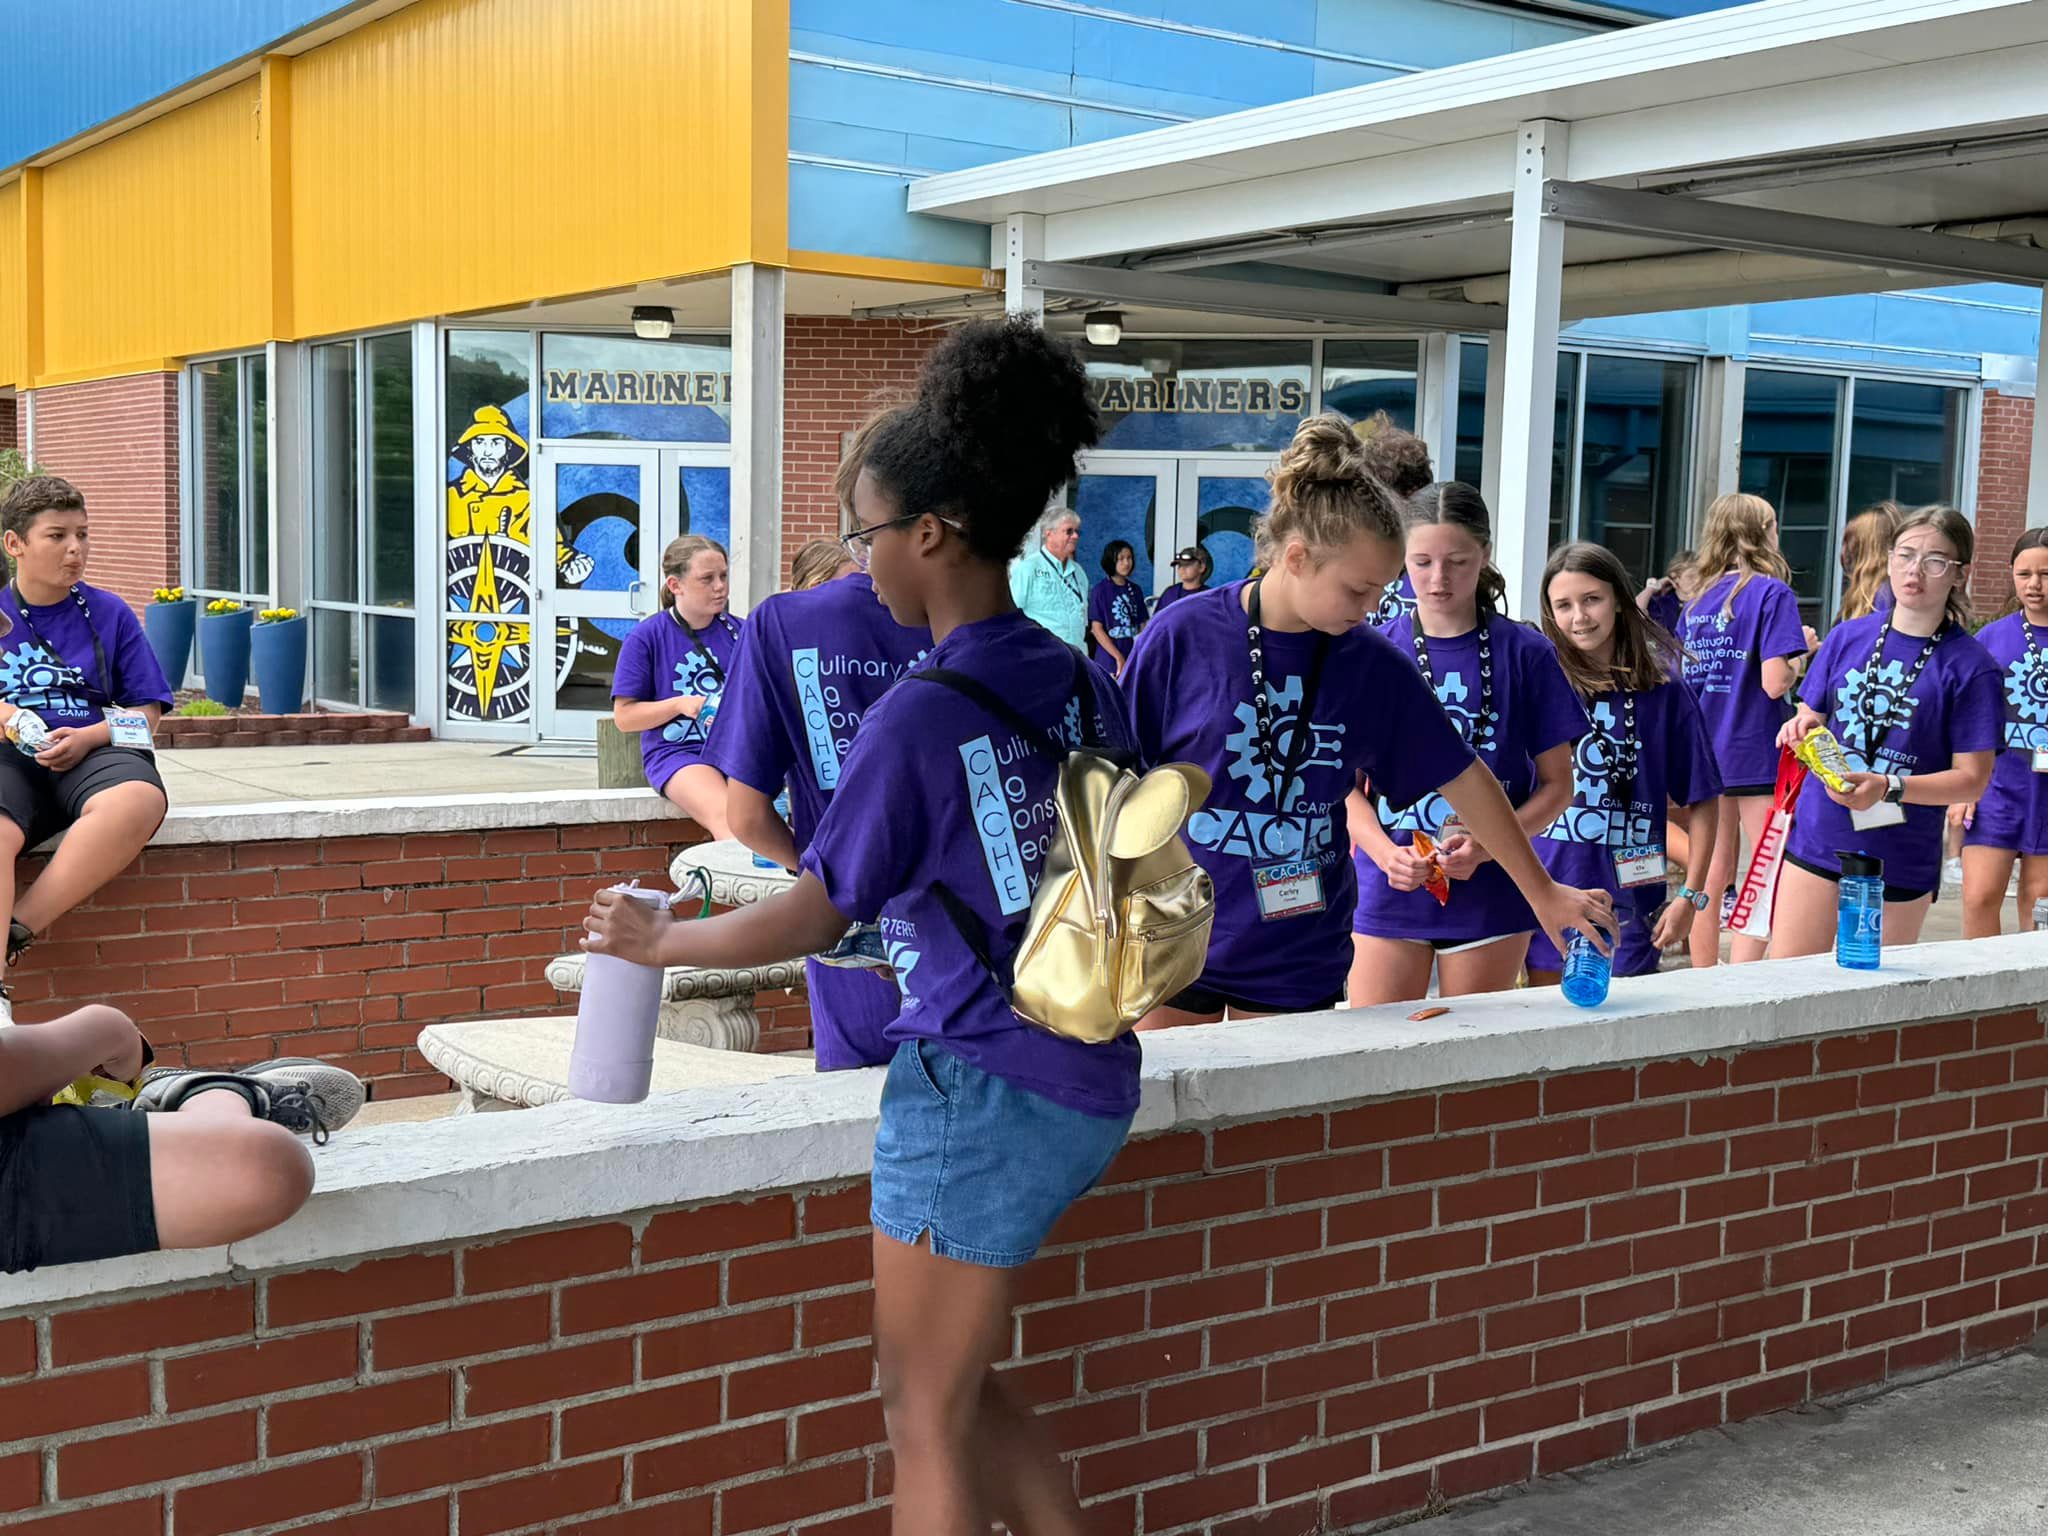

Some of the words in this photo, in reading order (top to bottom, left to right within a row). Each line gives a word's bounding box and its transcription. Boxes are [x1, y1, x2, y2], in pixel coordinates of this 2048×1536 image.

[1099, 377, 1305, 414] ARINERS
[57, 708, 90, 718] CAMP
[1875, 746, 1919, 765] ARTERET
[1601, 797, 1654, 814] CAERET
[1541, 806, 1652, 848] ACHE
[1270, 862, 1313, 881] CACHE
[881, 917, 917, 938] RTERET
